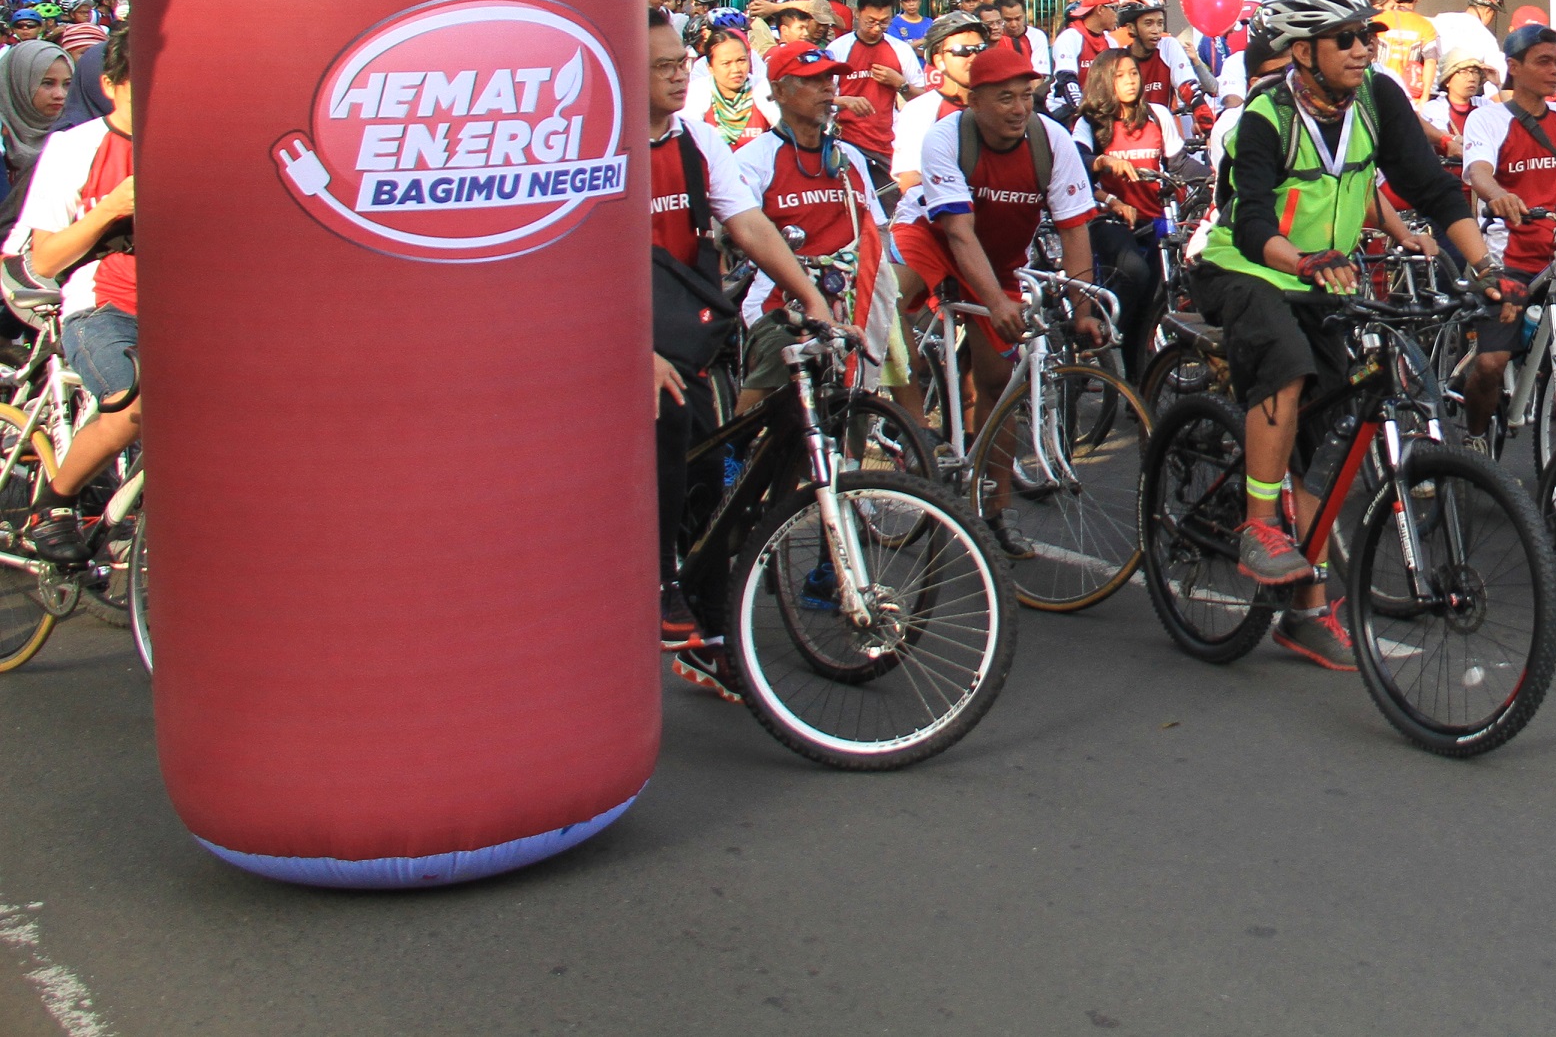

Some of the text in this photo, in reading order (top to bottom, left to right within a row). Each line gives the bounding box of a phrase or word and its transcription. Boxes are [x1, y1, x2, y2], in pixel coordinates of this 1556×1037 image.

[329, 67, 552, 120] HEMAT
[355, 115, 583, 171] ENERGI
[1508, 162, 1524, 173] LG
[371, 164, 622, 206] BAGIMU NEGERI
[778, 191, 800, 208] LG
[1076, 180, 1087, 191] LG
